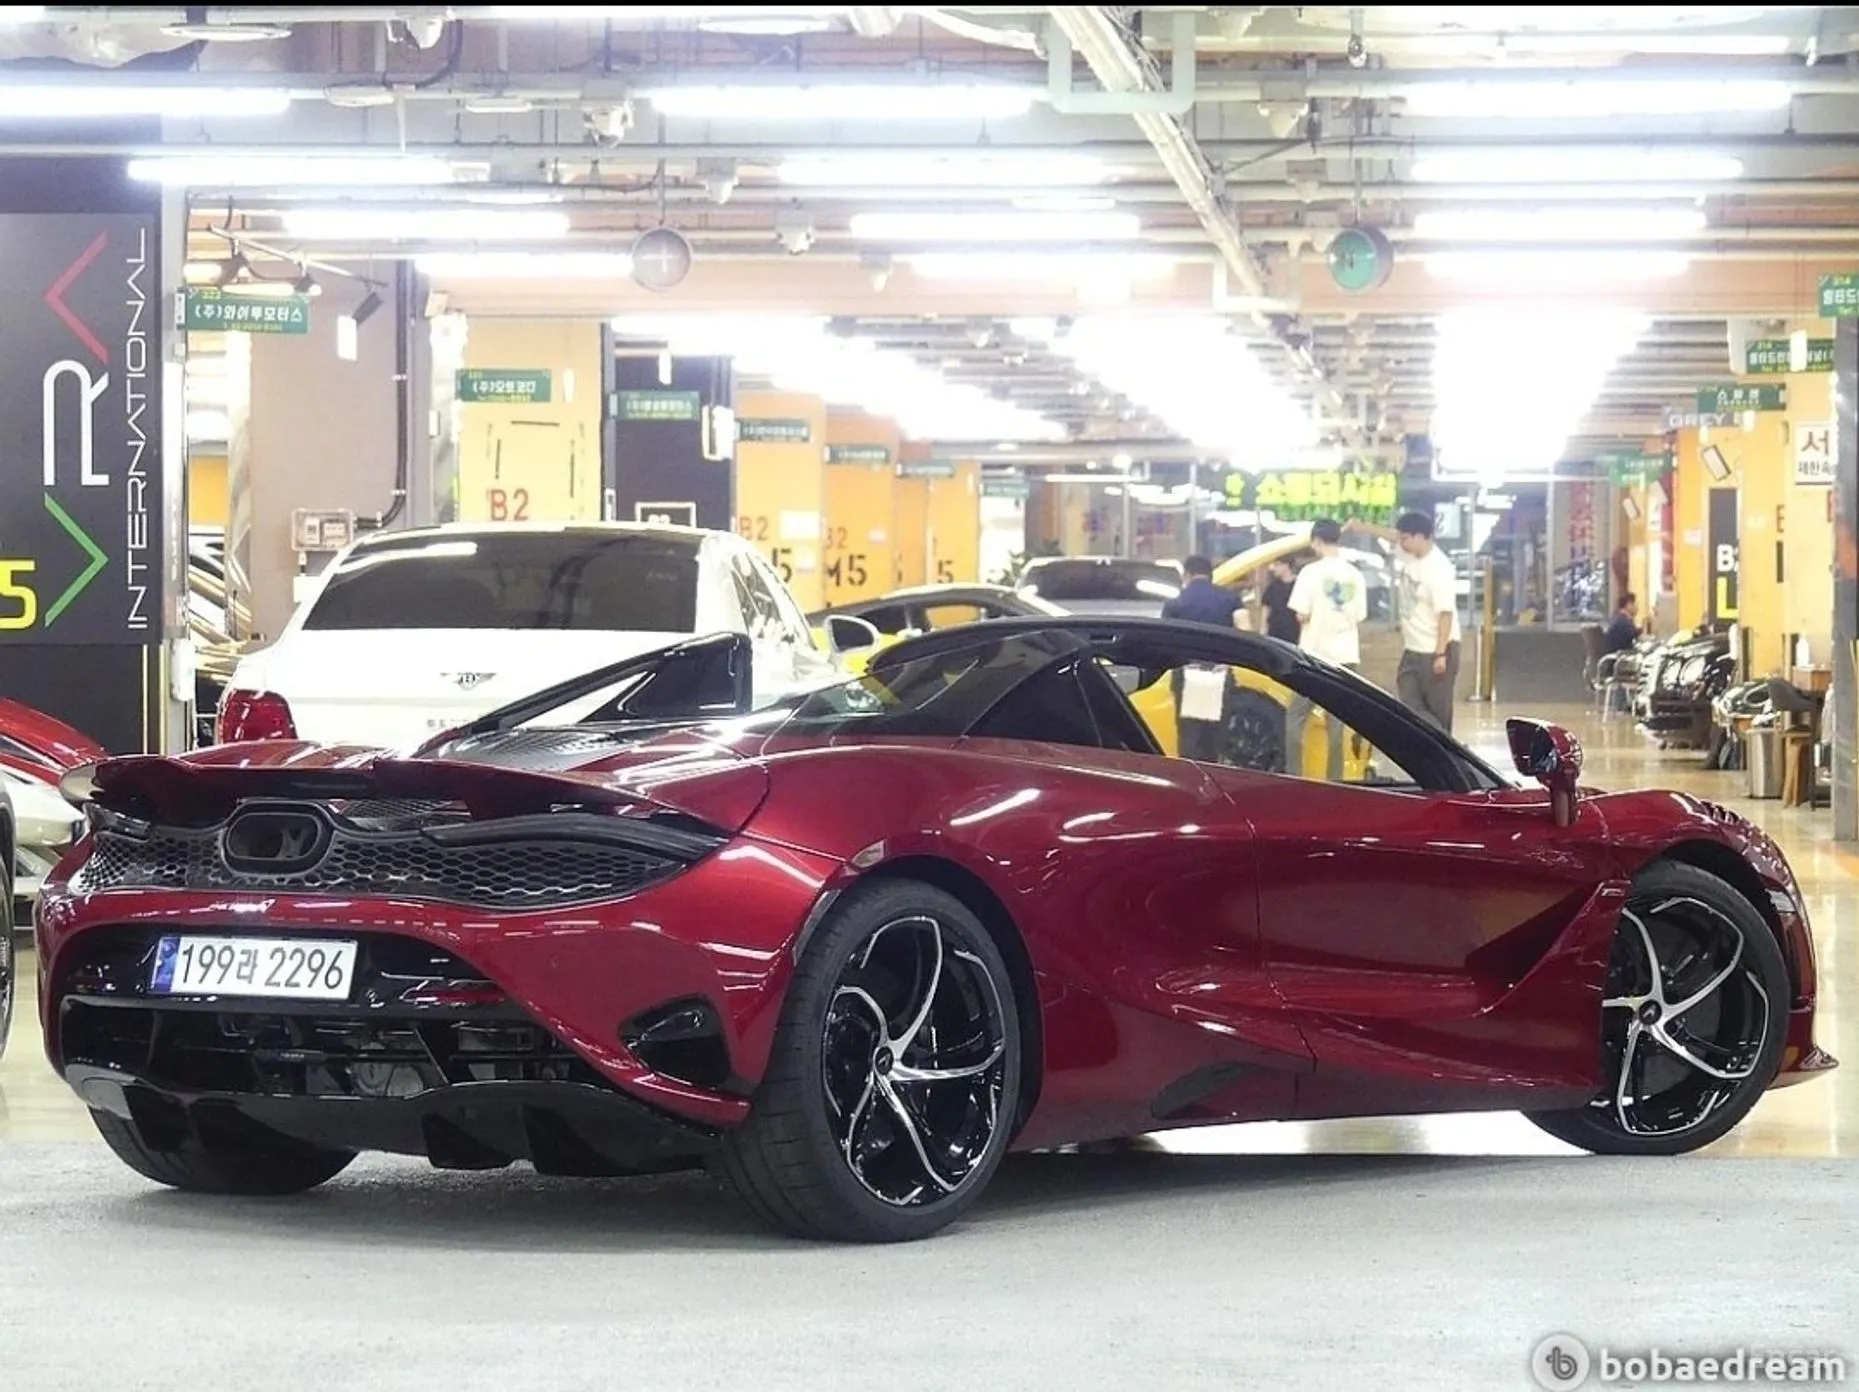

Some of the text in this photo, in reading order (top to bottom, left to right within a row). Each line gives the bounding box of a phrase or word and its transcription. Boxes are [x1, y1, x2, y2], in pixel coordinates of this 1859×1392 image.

[126, 228, 149, 629] INTERNATIONAL
[489, 488, 530, 521] B2
[739, 516, 769, 541] B2
[182, 943, 343, 990] 199라 2296
